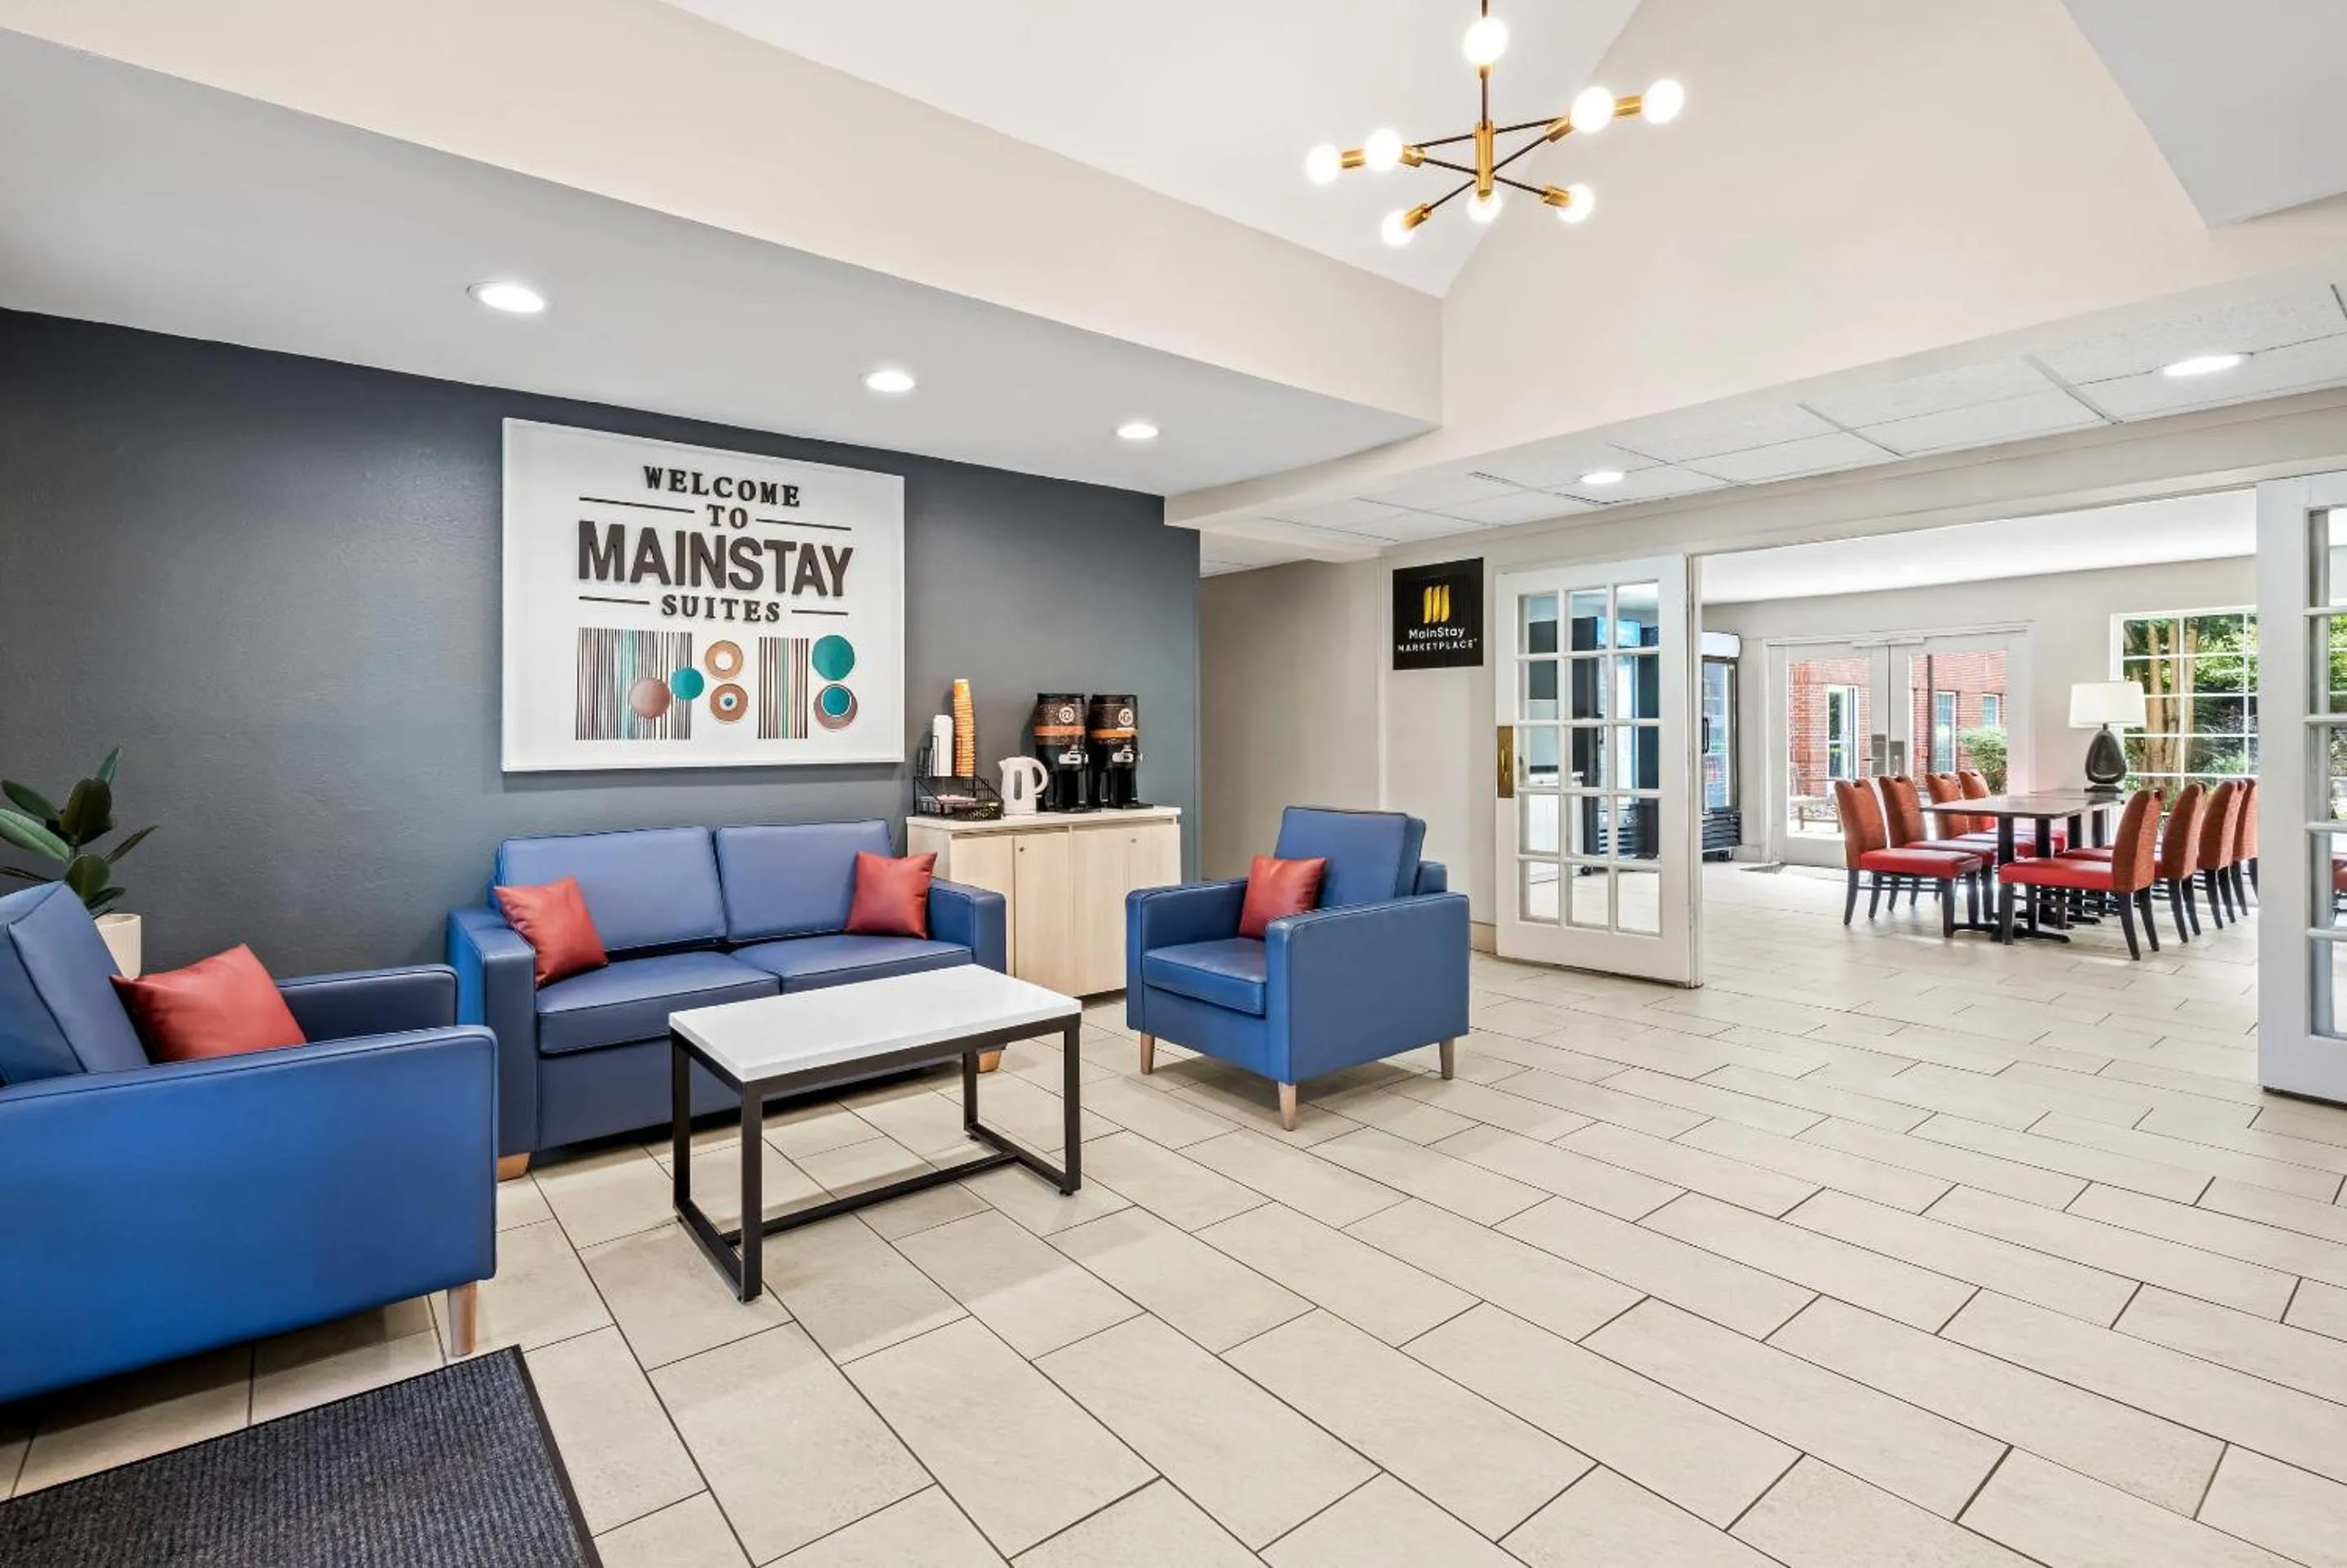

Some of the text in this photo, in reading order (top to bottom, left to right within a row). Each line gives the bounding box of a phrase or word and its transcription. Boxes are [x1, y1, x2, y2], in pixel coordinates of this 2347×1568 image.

[644, 465, 799, 507] WELCOME
[707, 504, 748, 529] TO
[578, 521, 854, 597] MAINSTAY
[661, 595, 781, 623] SUITES
[1398, 639, 1474, 652] MARKETPLACE
[1409, 627, 1465, 639] MainStay
